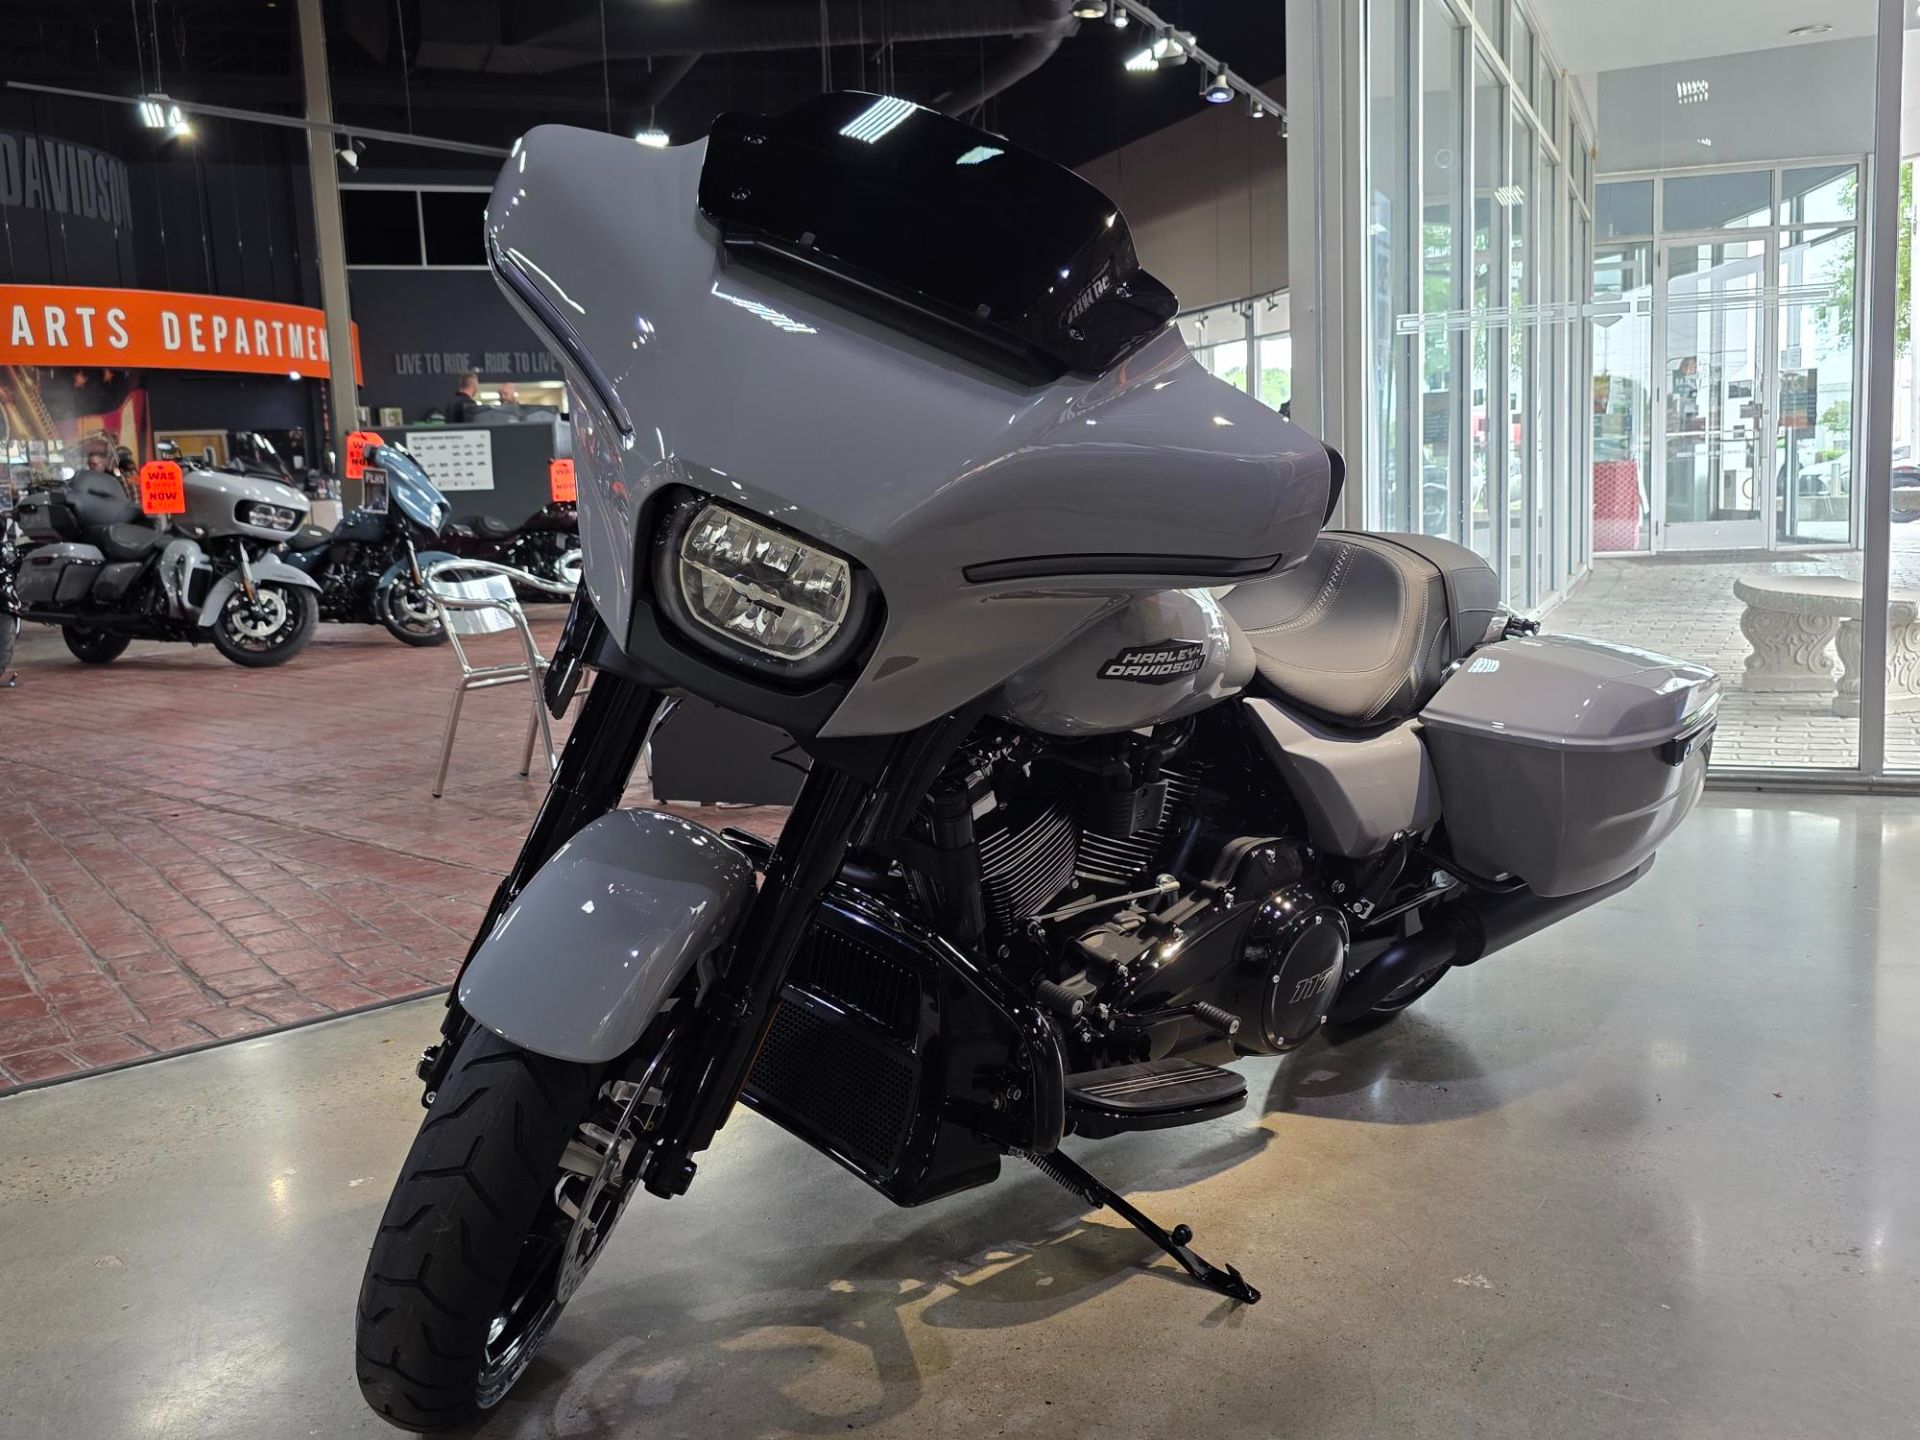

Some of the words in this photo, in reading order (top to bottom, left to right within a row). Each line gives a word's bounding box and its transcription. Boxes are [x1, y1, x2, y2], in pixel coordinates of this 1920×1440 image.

[0, 133, 133, 231] DAVIDSON
[11, 304, 129, 349] ARTS
[162, 311, 330, 362] DEPARTMEN
[395, 353, 423, 375] LIVE
[424, 353, 443, 374] TO
[484, 352, 512, 374] RIDE
[513, 352, 531, 373] TO
[147, 472, 175, 480] WAS
[150, 492, 177, 500] NOW
[1105, 657, 1203, 676] DAVIDSON
